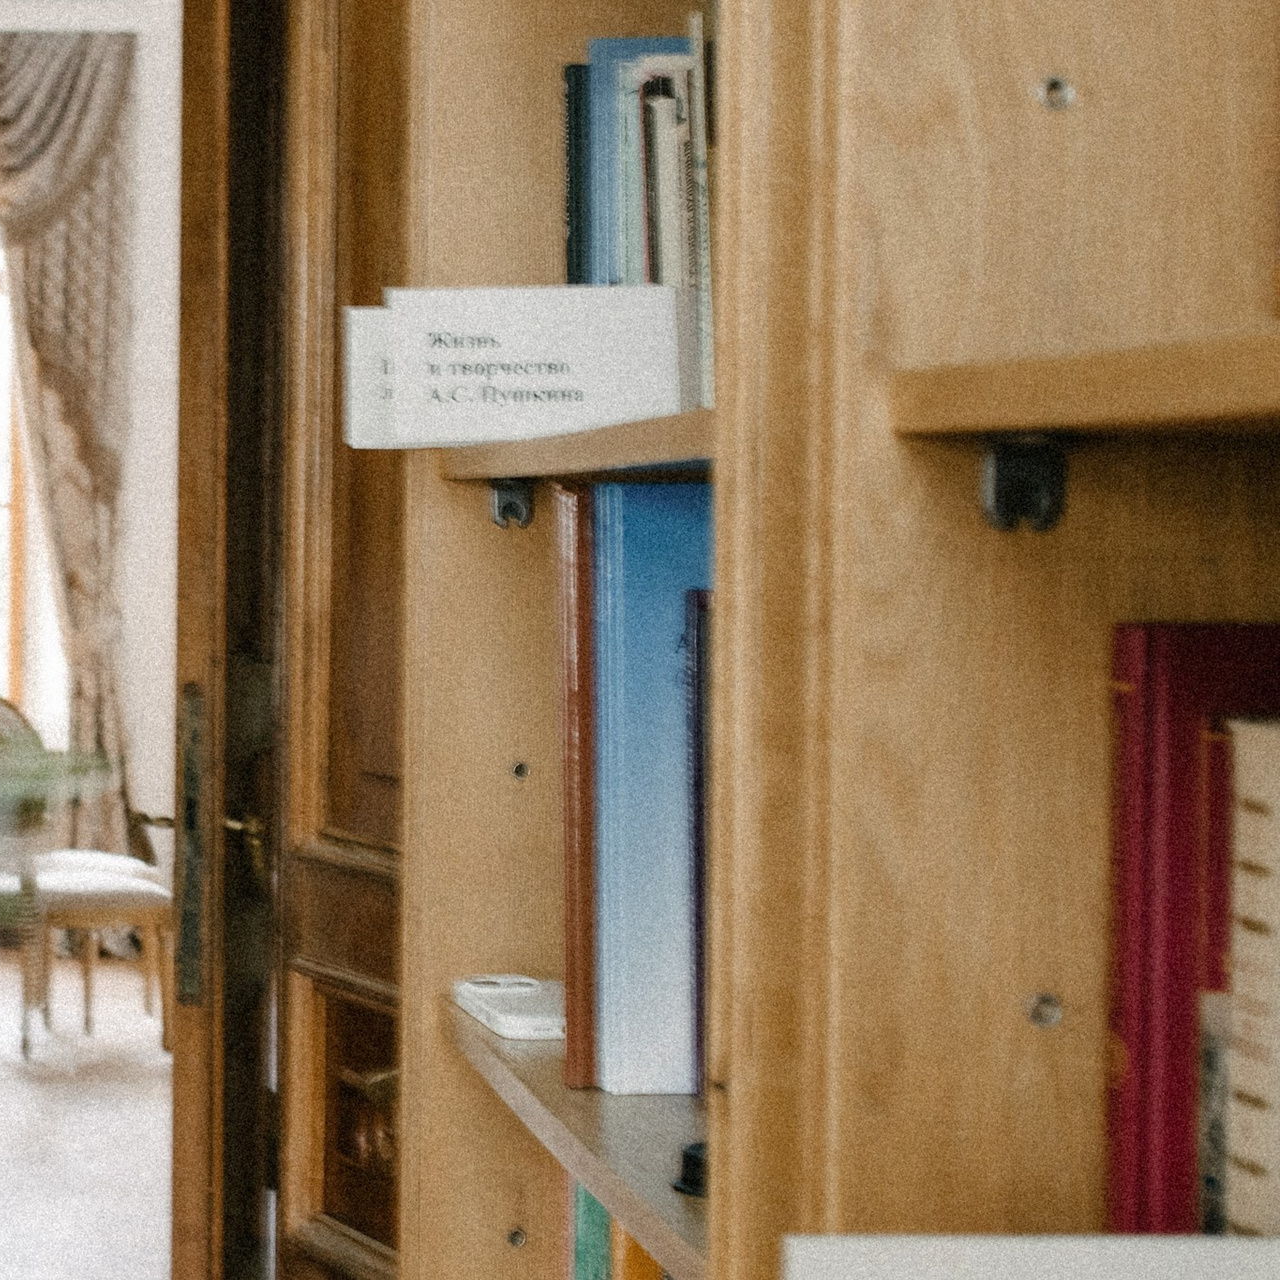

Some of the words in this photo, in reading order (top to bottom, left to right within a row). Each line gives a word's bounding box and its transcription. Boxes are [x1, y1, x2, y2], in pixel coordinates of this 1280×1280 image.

[428, 331, 502, 349] Жизнь
[429, 362, 442, 376] и
[448, 361, 571, 380] творчество
[430, 387, 474, 404] А.С.
[481, 385, 585, 407] Пушкина
